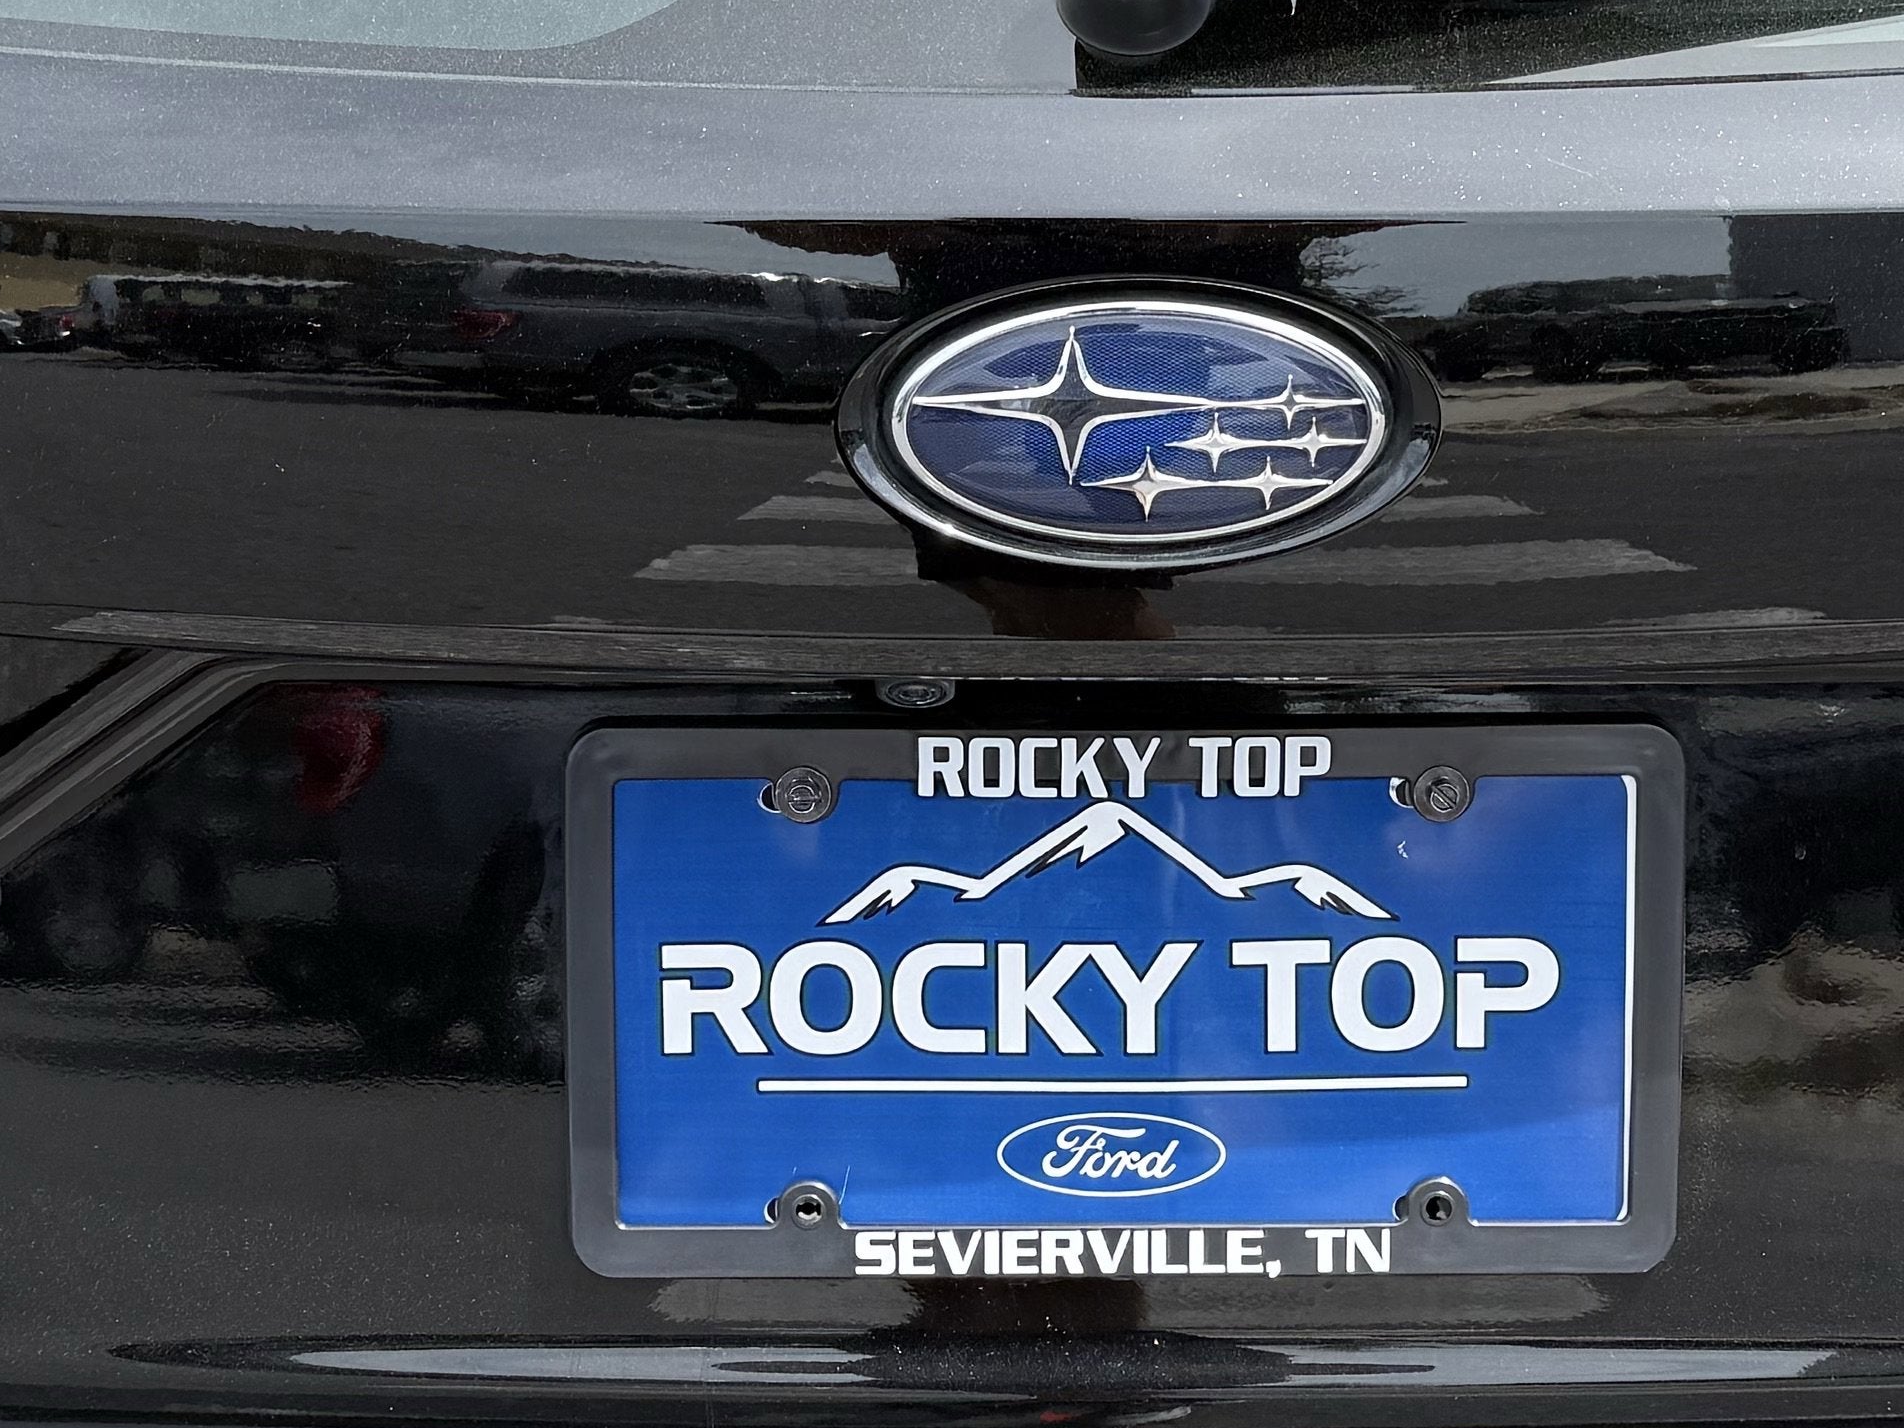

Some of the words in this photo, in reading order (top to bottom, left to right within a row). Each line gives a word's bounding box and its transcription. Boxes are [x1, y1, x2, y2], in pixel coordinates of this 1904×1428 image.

[917, 736, 1161, 799] ROCKY
[1187, 735, 1335, 798] TOP
[659, 940, 1201, 1056] ROCKY
[1229, 936, 1561, 1053] TOP
[1040, 1120, 1181, 1184] Ford
[854, 1228, 1281, 1279] SEVIERVILLE,
[1304, 1228, 1393, 1275] TN
